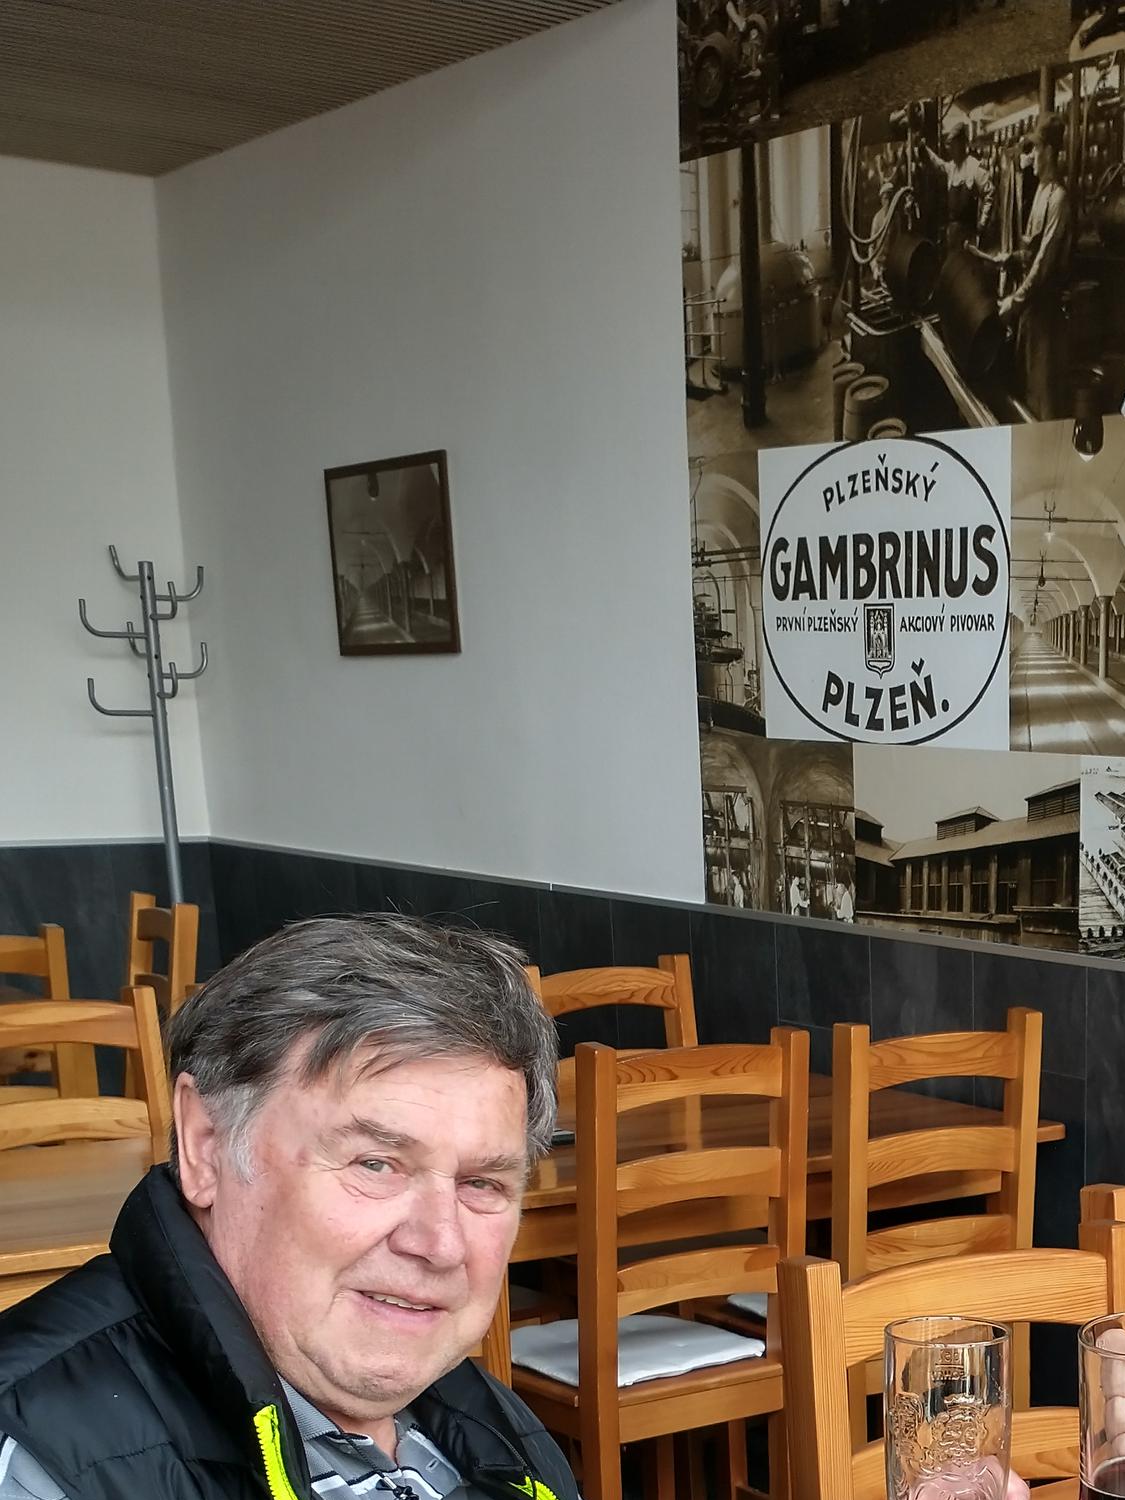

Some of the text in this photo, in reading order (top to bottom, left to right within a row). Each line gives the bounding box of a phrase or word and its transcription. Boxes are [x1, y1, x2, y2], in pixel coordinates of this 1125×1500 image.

[822, 453, 939, 512] PLZEŇSKÝ
[769, 524, 999, 602] GAMBRINUS
[776, 603, 995, 633] PRVNÍ PLZEŇSKÝ AKCIOVÝ PIVOVAR
[822, 657, 950, 732] PLZEŇ.
